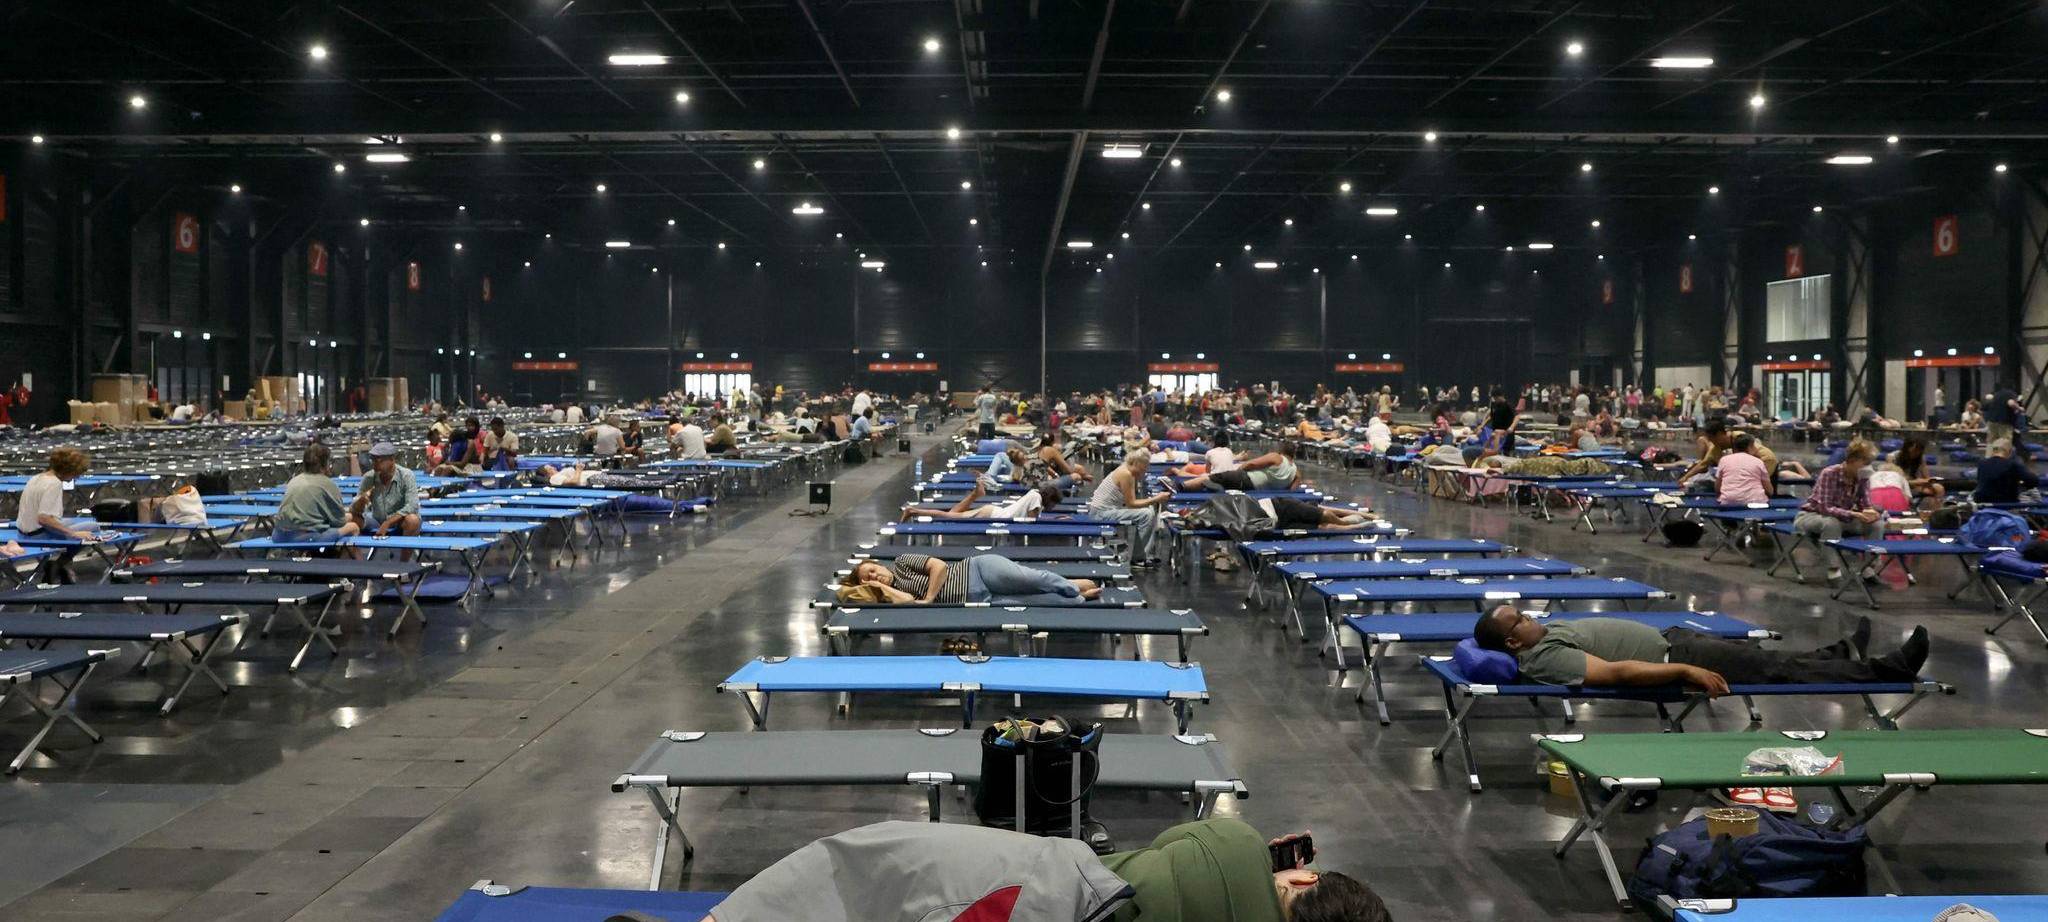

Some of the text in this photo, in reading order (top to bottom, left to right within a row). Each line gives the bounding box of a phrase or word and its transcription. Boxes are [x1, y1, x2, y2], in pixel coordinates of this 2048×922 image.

[180, 216, 193, 248] 6
[1938, 219, 1952, 252] 6
[313, 243, 323, 270] 7
[409, 262, 418, 287] 8
[1682, 266, 1690, 290] 8
